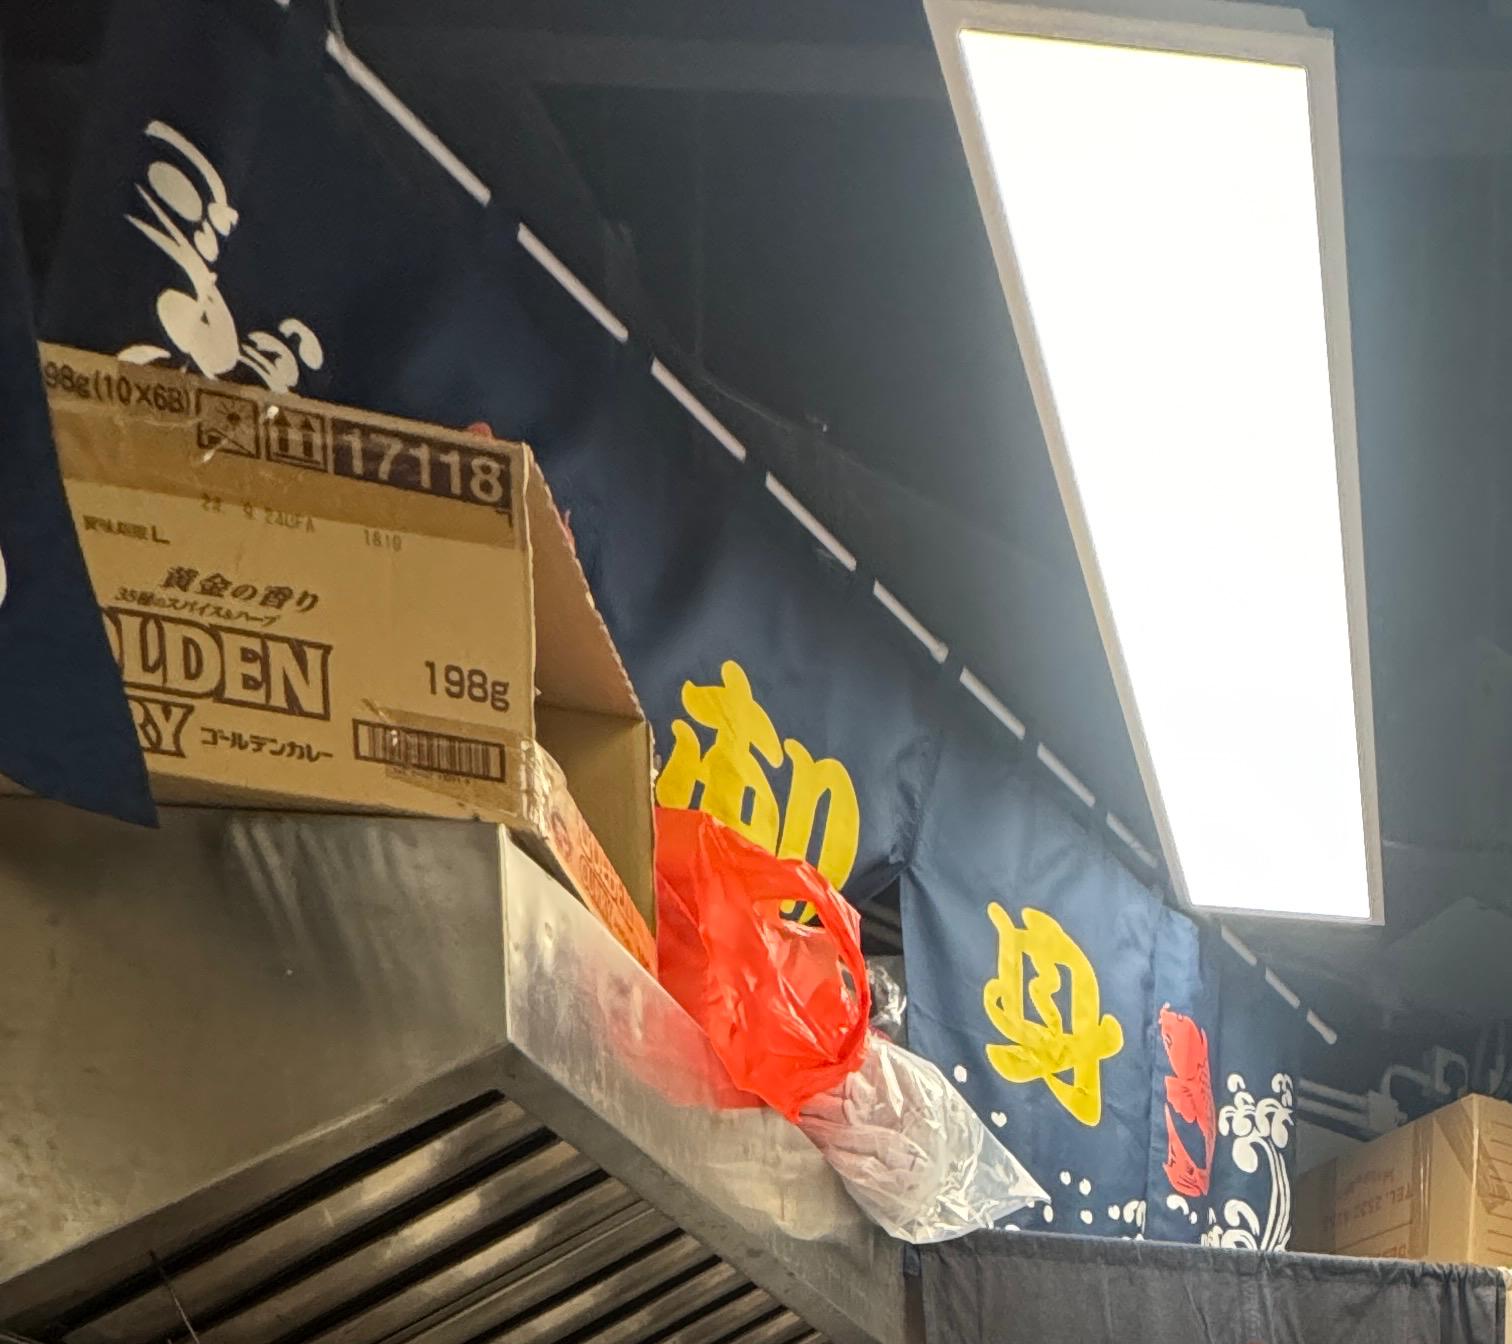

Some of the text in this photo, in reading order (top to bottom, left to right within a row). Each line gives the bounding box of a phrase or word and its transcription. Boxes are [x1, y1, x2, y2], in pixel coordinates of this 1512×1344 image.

[343, 427, 504, 503] 17118
[160, 566, 319, 612] 黄金の香り
[424, 660, 510, 713] 198g
[201, 727, 334, 762] ゴールデンカレー
